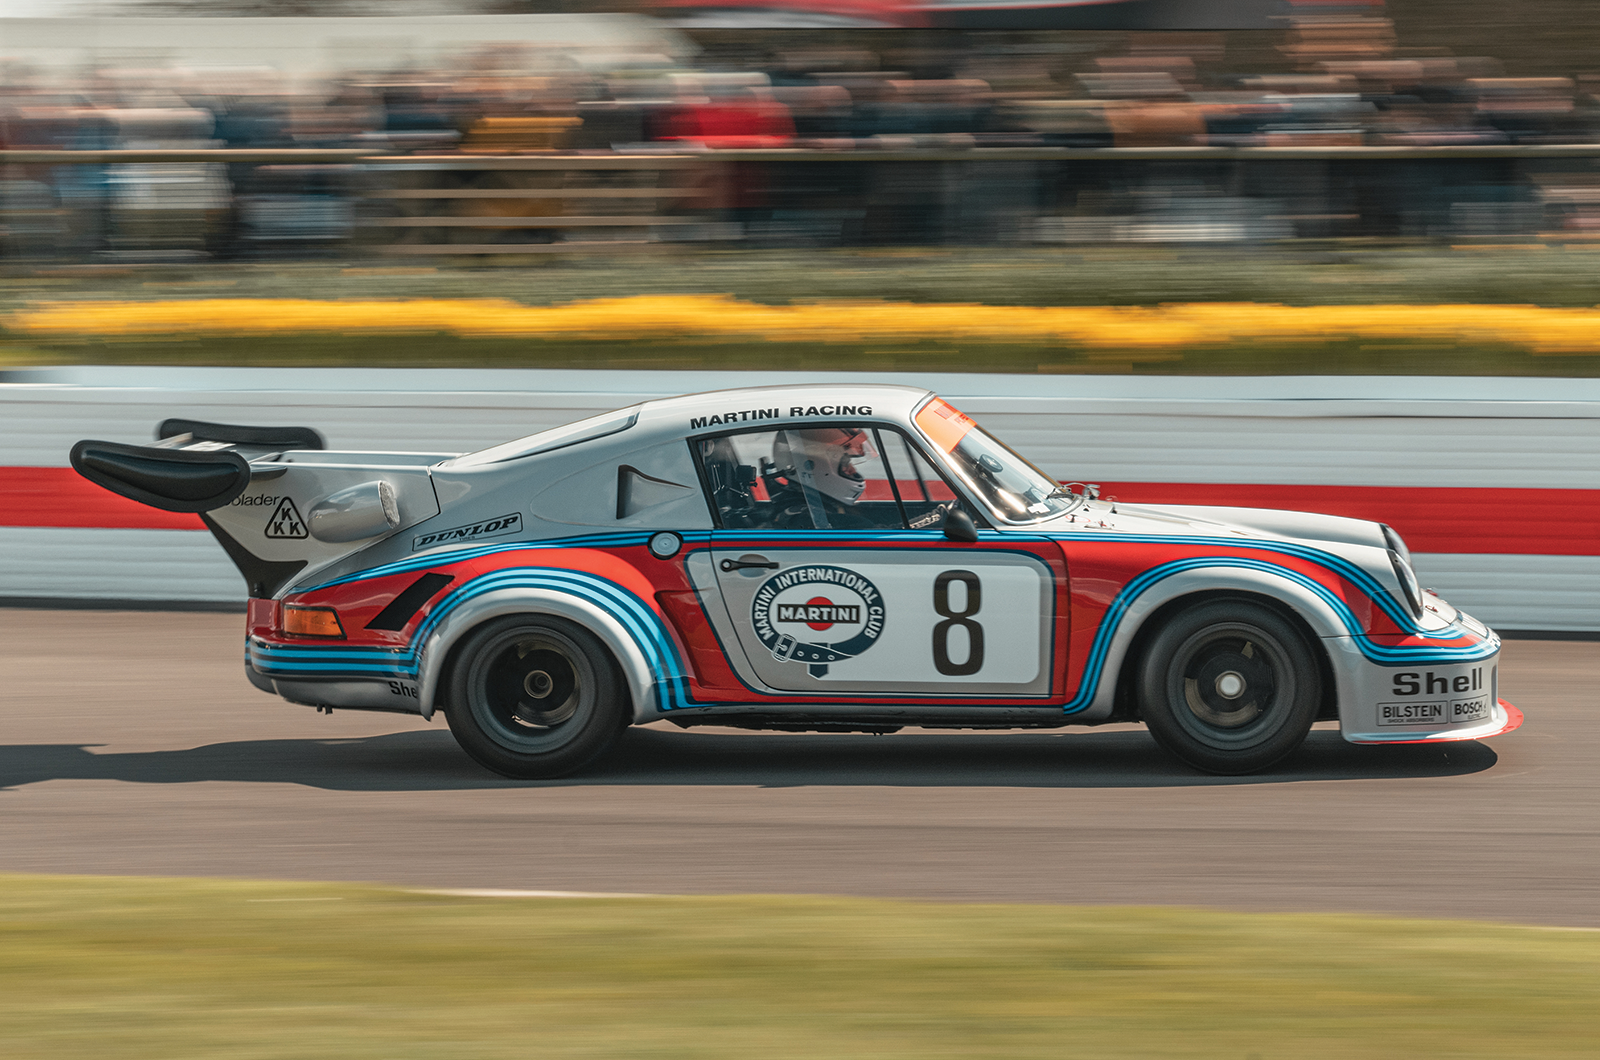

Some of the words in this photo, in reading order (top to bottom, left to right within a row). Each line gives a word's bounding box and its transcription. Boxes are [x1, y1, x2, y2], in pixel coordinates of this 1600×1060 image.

[690, 408, 780, 430] MARTINI
[789, 405, 873, 417] RACING
[231, 493, 281, 507] olader
[416, 516, 519, 547] DUNLOP
[754, 585, 777, 641] MARTINI
[774, 567, 879, 605] INTERNATIONAL
[863, 605, 884, 640] CLUB
[779, 606, 858, 621] MARTINI
[932, 569, 985, 676] 8
[1392, 667, 1482, 696] Shell
[1383, 704, 1442, 718] BILSTEIN
[1454, 700, 1483, 715] BOSCH
